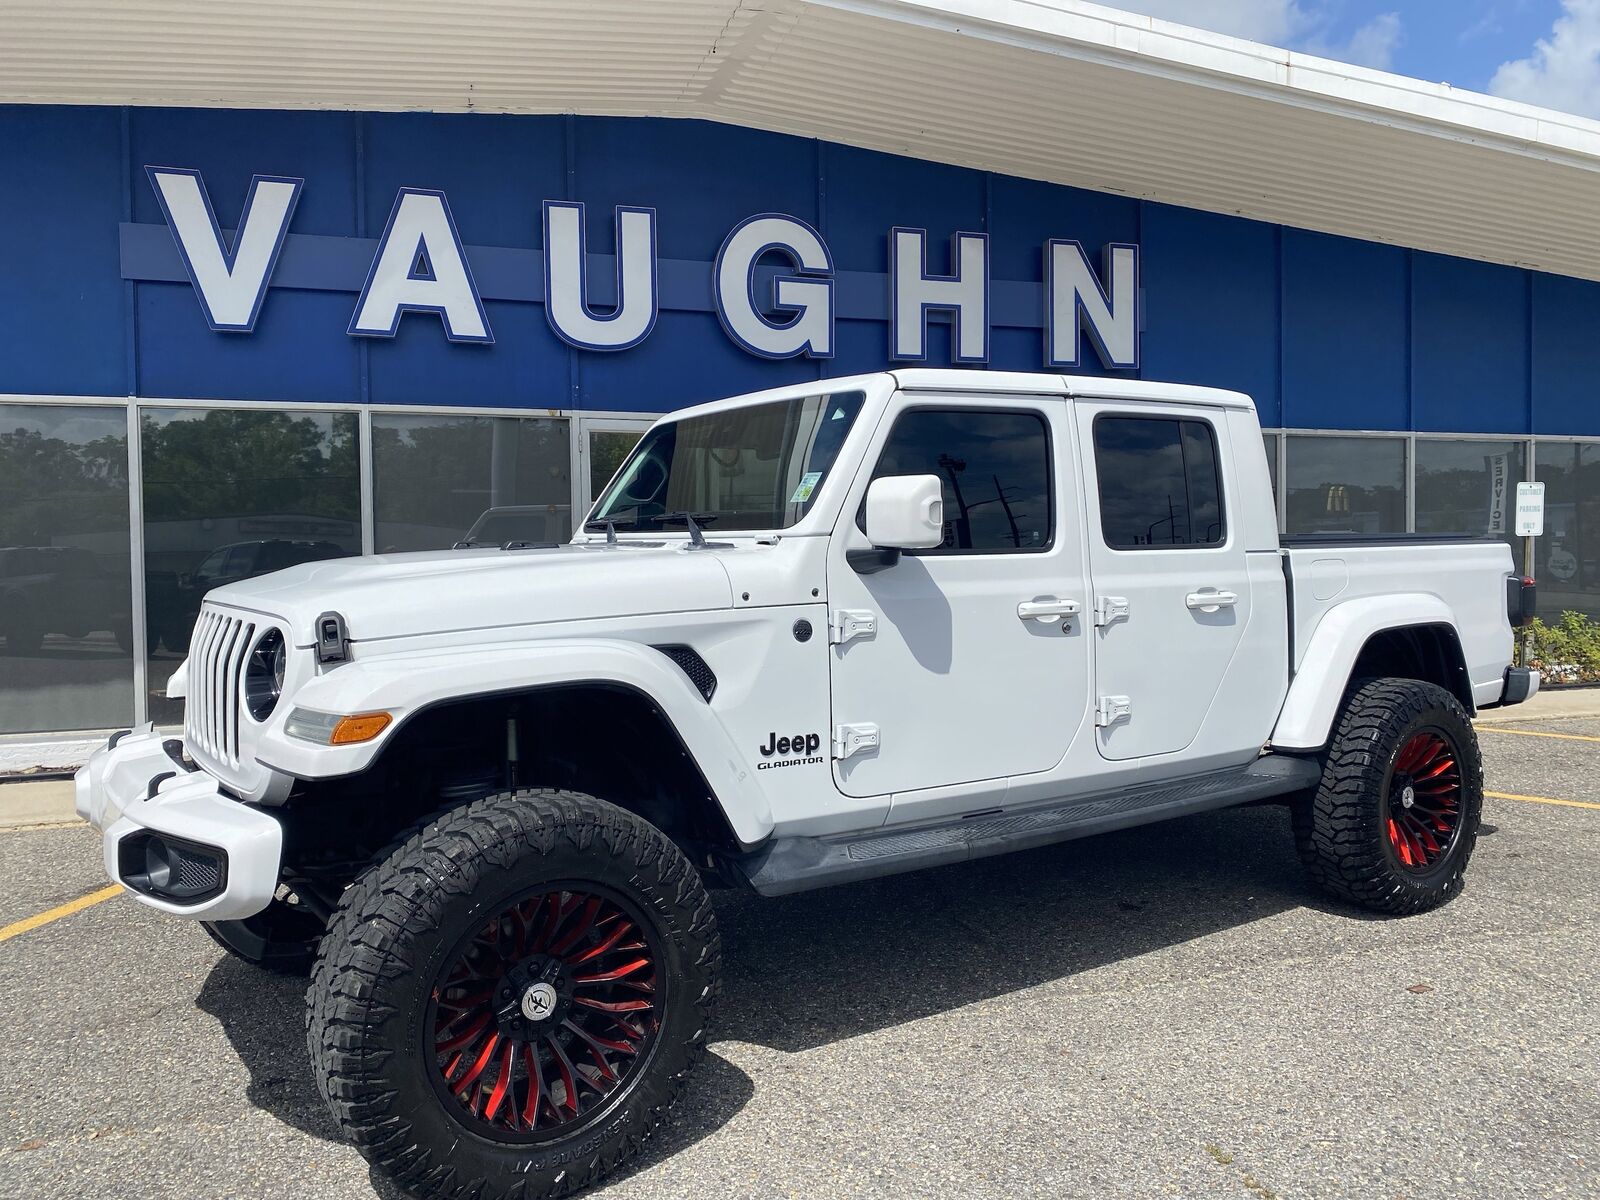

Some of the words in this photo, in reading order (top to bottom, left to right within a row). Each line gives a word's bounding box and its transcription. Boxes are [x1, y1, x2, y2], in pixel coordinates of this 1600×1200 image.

[145, 165, 1140, 369] VAUGHN
[1519, 505, 1541, 513] PARKING
[760, 732, 820, 756] Jeep
[757, 756, 824, 770] GLADIATOR
